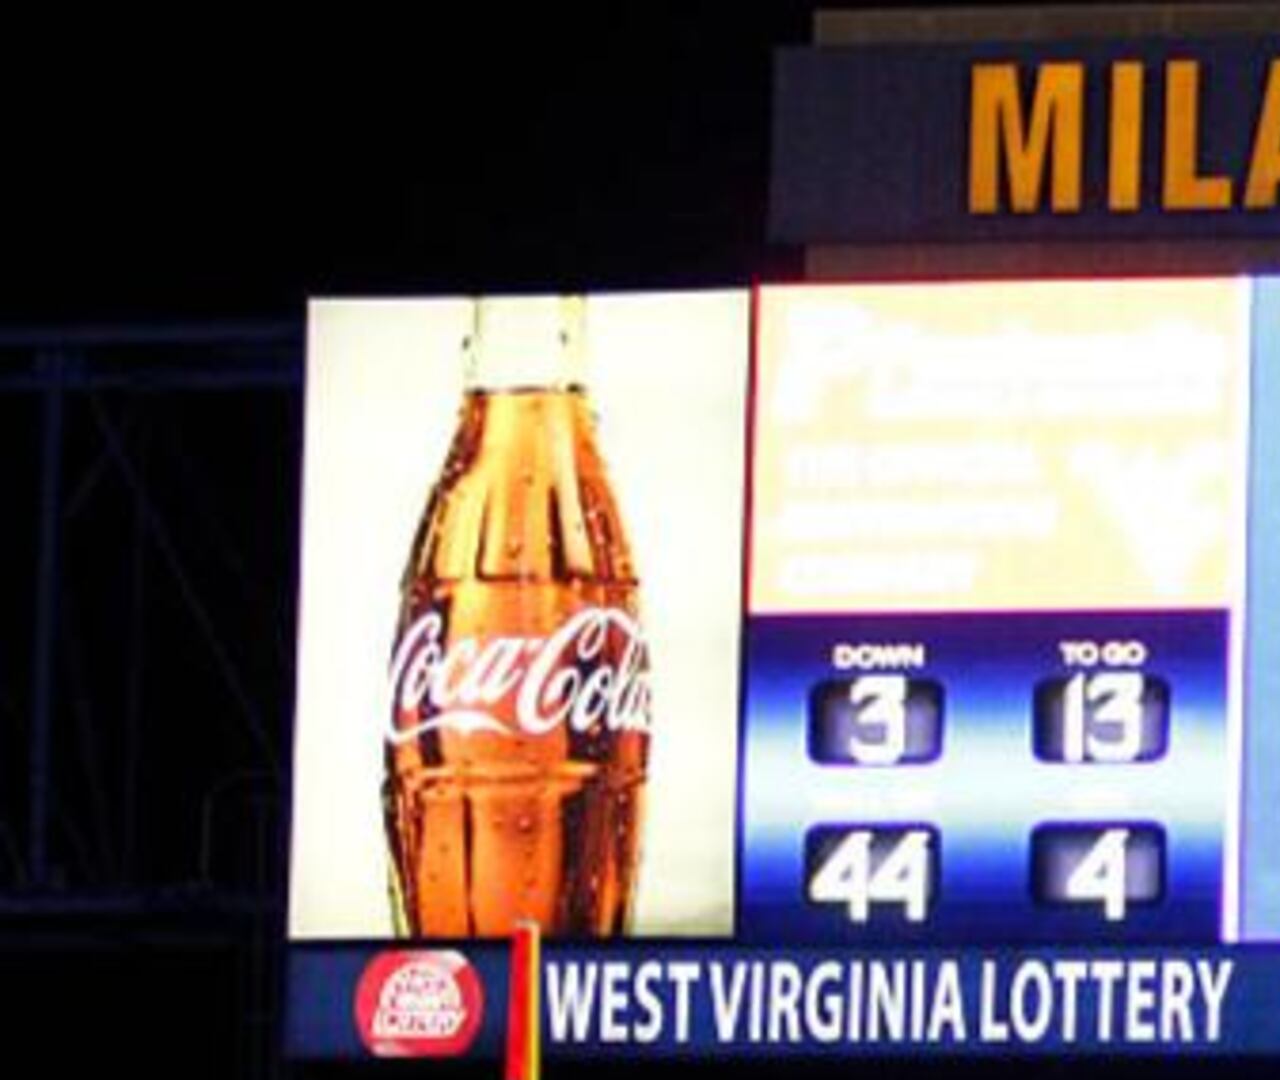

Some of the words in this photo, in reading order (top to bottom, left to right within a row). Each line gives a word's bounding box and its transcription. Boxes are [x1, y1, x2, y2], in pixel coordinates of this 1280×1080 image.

[832, 643, 925, 670] DOWN
[1059, 641, 1099, 667] TO
[1100, 640, 1147, 667] GO
[849, 673, 906, 766] 3
[1062, 671, 1145, 763] 13
[809, 829, 930, 923] 44
[1065, 827, 1129, 921] 4
[545, 960, 701, 1044] WEST
[709, 959, 967, 1044] VIRGINIA
[981, 958, 1234, 1043] LOTTERY
